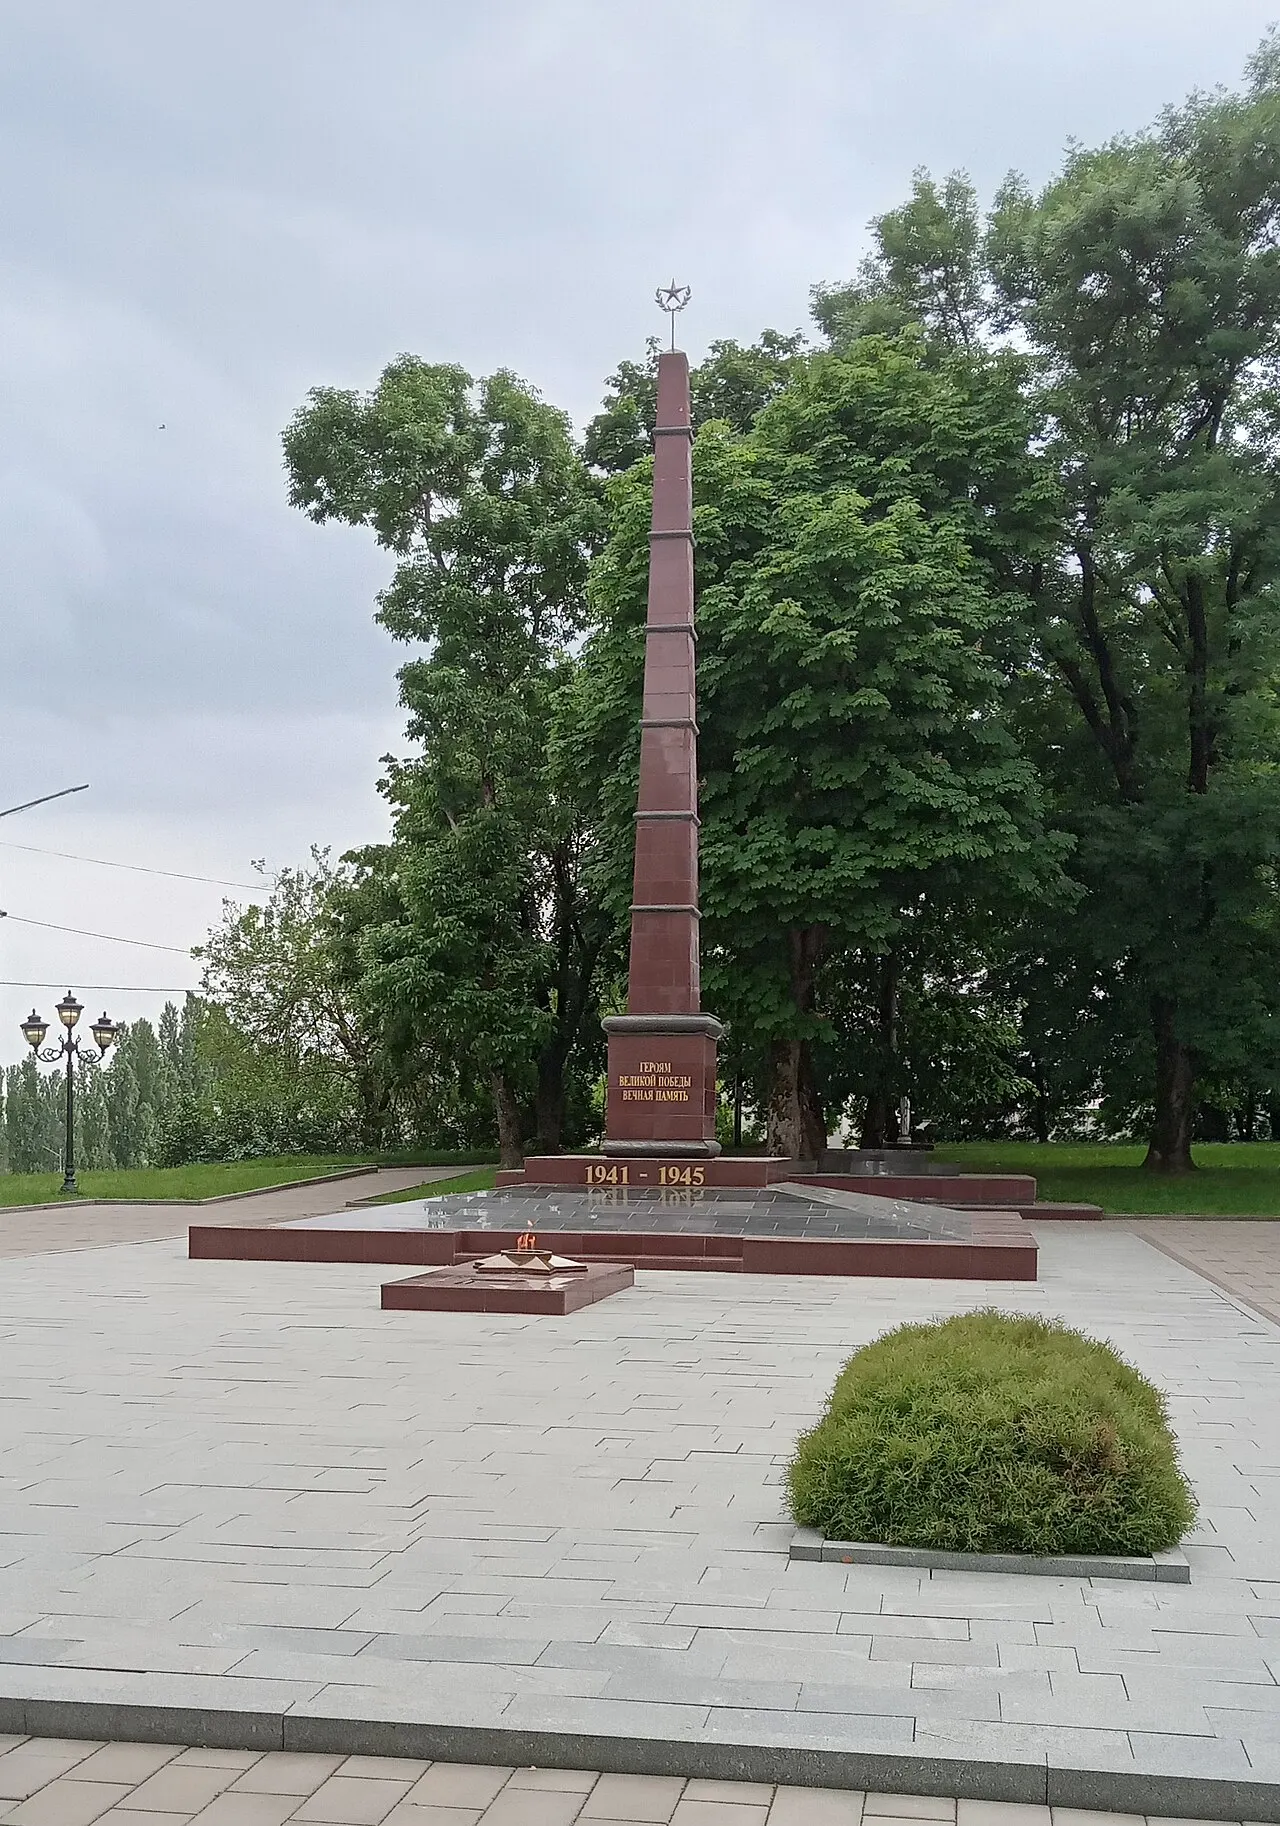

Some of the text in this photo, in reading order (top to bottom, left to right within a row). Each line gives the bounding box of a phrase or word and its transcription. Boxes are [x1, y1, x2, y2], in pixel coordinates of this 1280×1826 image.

[640, 1062, 672, 1073] ГЕРОЯМ
[619, 1074, 691, 1088] ВЕЛИКОЙ ПОБЕДЫ
[622, 1090, 689, 1102] ВЕЧНАЯ ПАМЯТЬ
[585, 1165, 630, 1184] 1941
[658, 1166, 705, 1186] 1945
